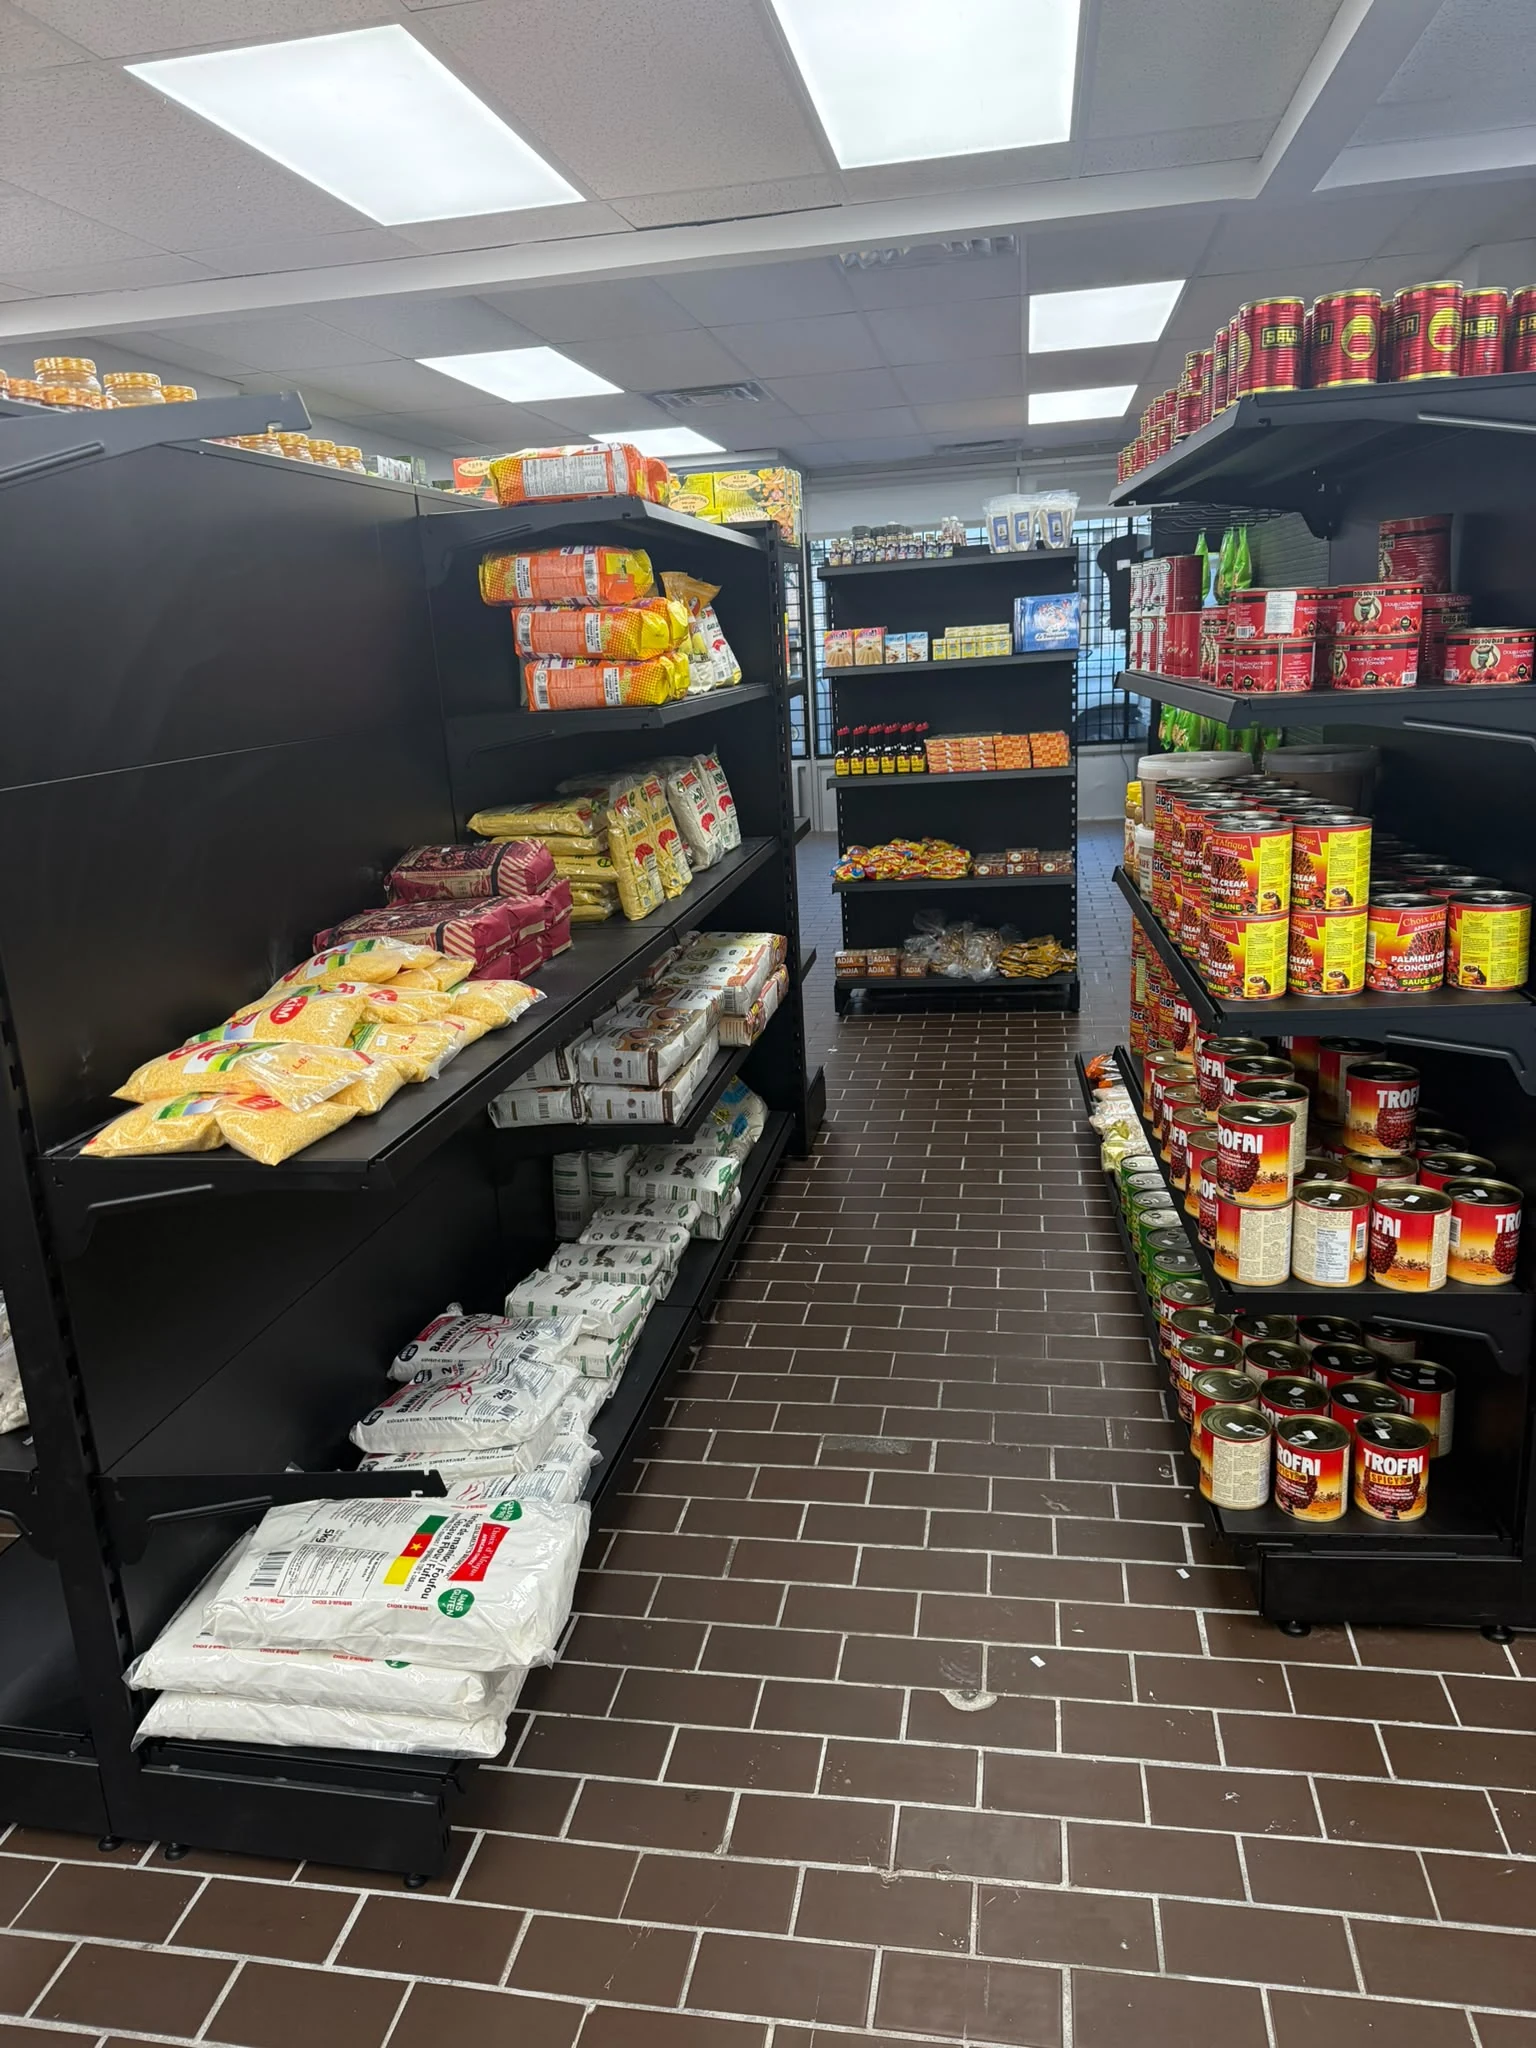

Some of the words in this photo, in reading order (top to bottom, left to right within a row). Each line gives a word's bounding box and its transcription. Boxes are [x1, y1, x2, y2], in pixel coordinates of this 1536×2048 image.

[1266, 327, 1299, 344] SALS
[1220, 879, 1249, 889] CREAM
[1402, 915, 1429, 928] Choix
[1414, 920, 1437, 932] AFRICAN
[837, 957, 854, 965] ADJA
[873, 955, 891, 963] ADJA
[1391, 953, 1435, 963] PALMNUT
[841, 966, 858, 975] ADJA
[868, 966, 885, 974] ADJA
[905, 966, 921, 974] ADJA
[1211, 960, 1236, 971] CREAM
[1397, 960, 1444, 972] CONCENTR
[1402, 977, 1430, 986] SAUCE
[1176, 1005, 1193, 1023] FAI
[1200, 1055, 1225, 1079] OFAI
[1377, 1085, 1419, 1109] TROF
[1496, 1211, 1522, 1235] TRO
[1278, 1444, 1321, 1477] ROFAI
[1363, 1449, 1424, 1476] TROFAI
[1371, 1474, 1400, 1486] SPICY
[315, 1528, 335, 1544] 5kg
[435, 1541, 450, 1561] Flour
[417, 1563, 436, 1583] Fufu
[420, 1568, 445, 1600] Foufou
[445, 1589, 462, 1616] GLUTEN
[454, 1593, 469, 1612] SANS
